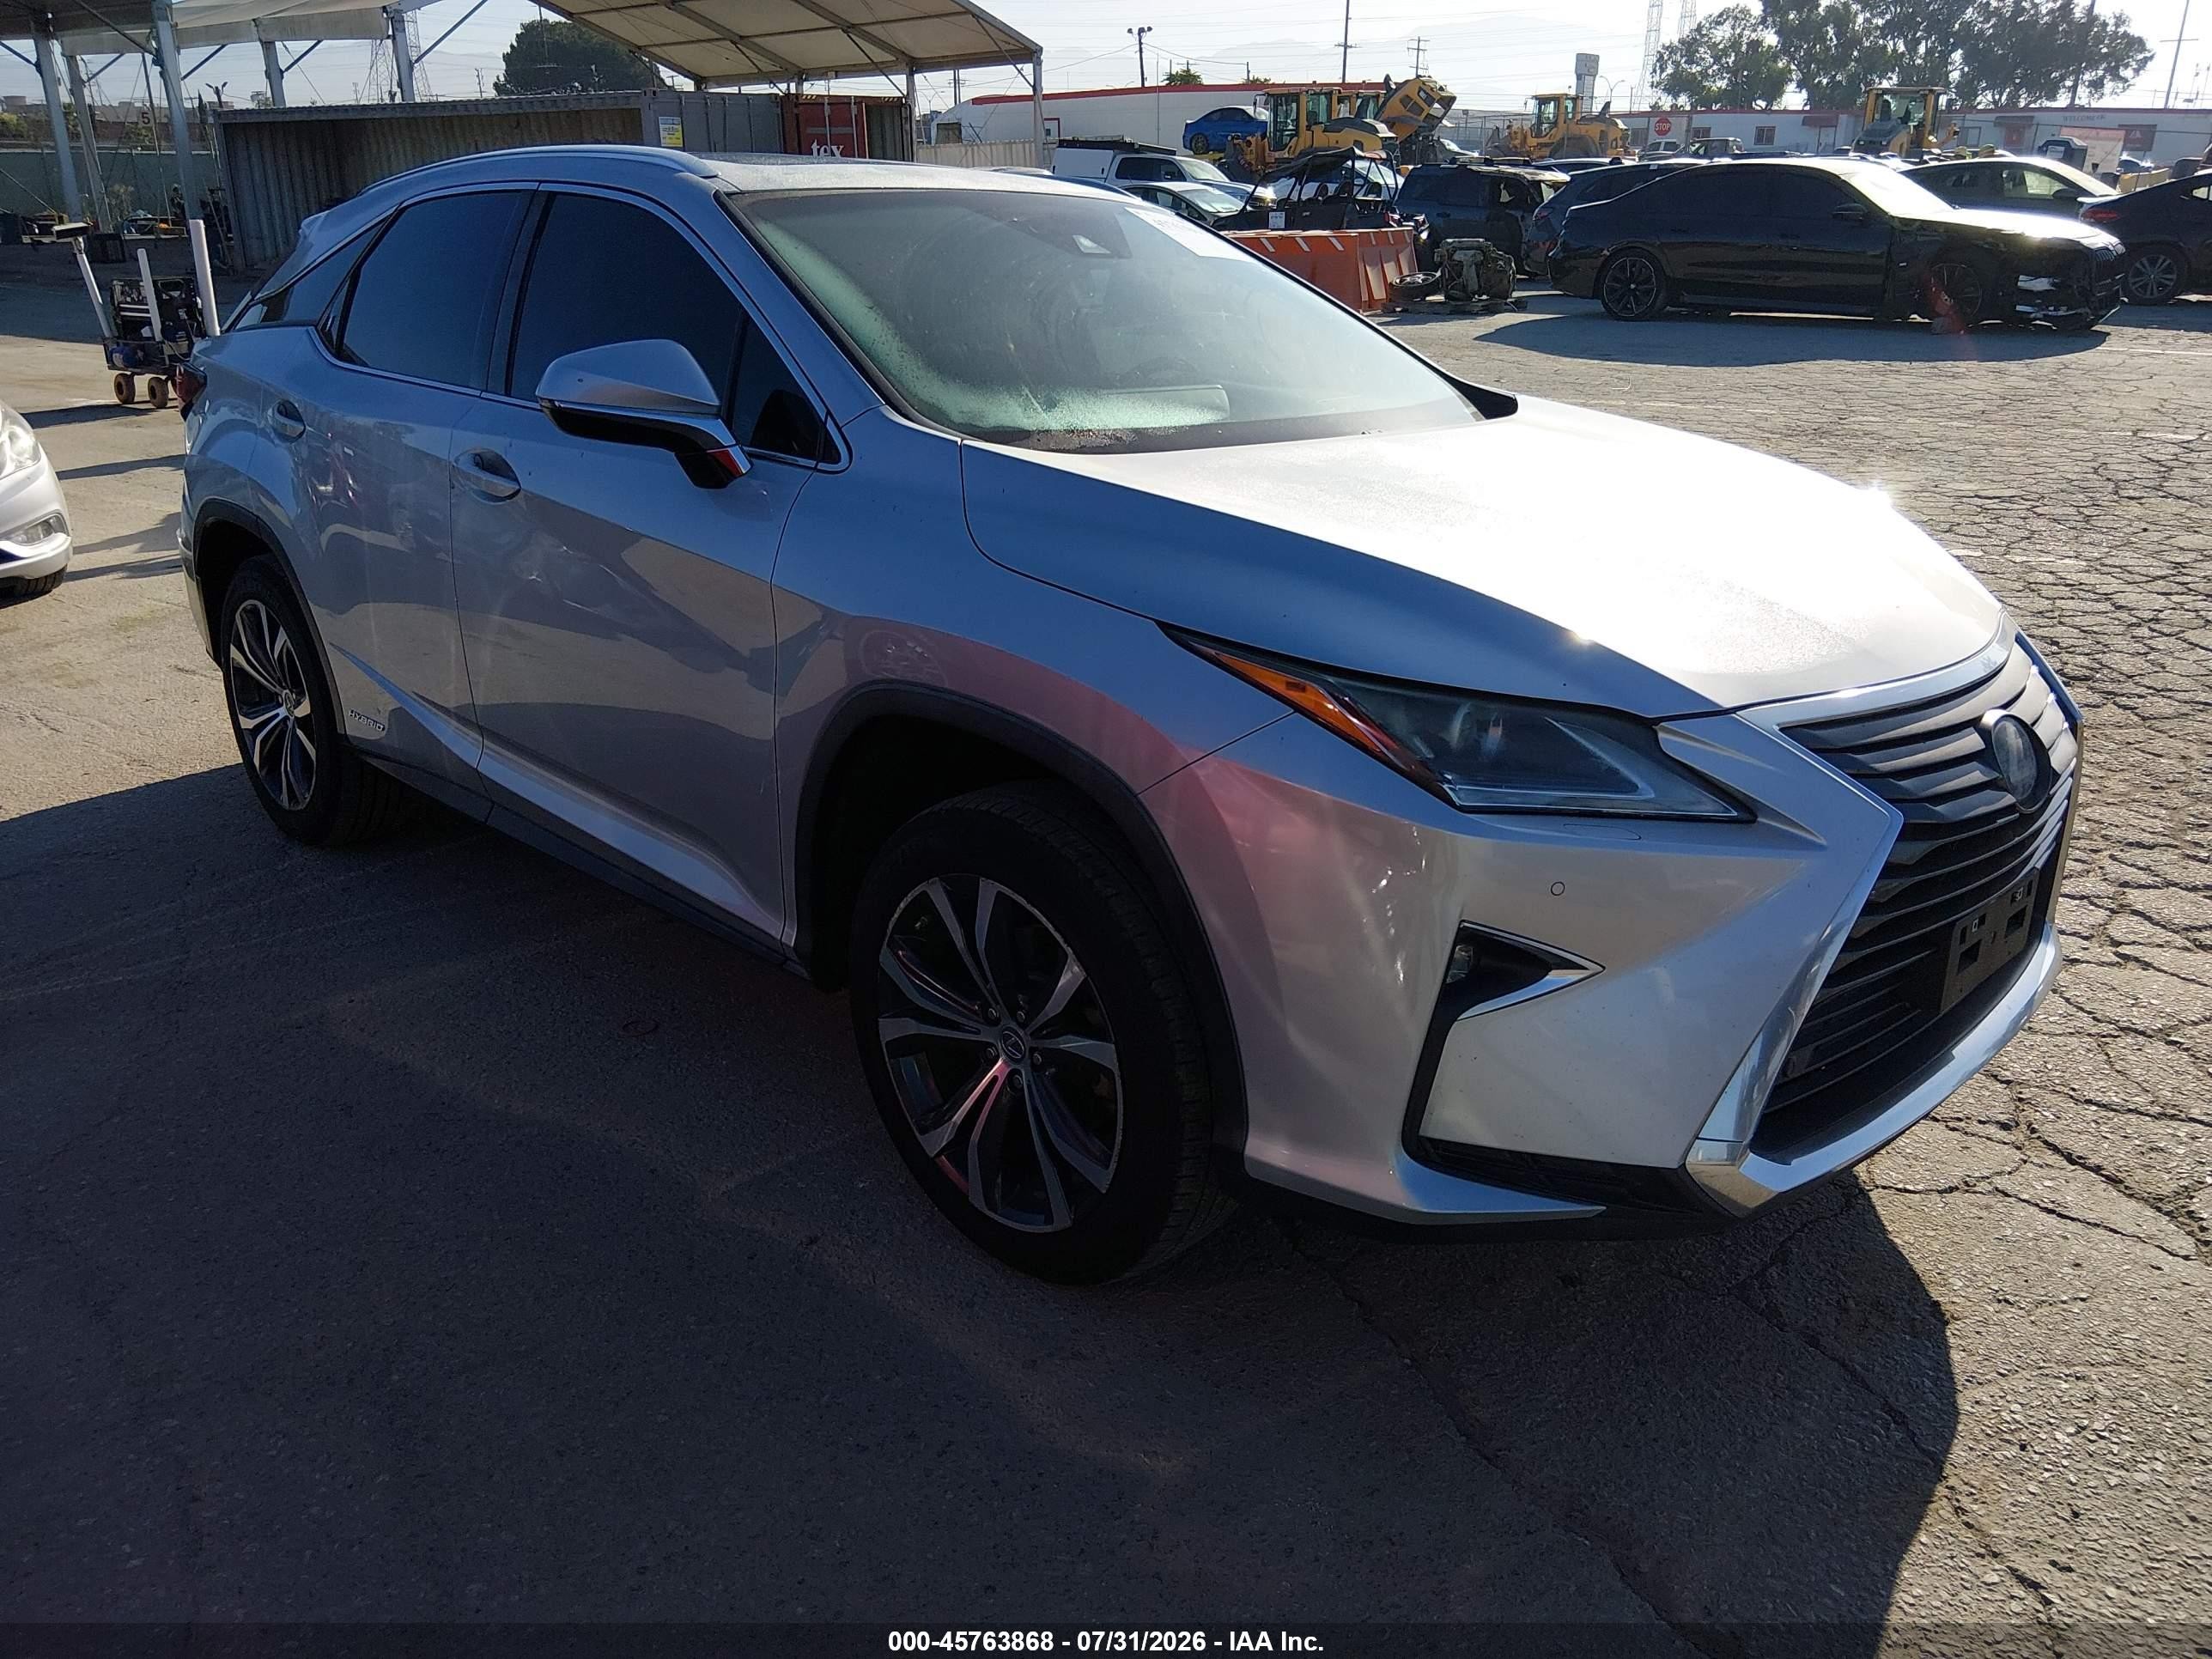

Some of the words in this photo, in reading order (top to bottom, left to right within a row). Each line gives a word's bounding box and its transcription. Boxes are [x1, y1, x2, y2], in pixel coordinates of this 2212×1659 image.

[142, 112, 150, 125] 5
[1655, 123, 1671, 131] STOP
[349, 708, 385, 732] HYBRID
